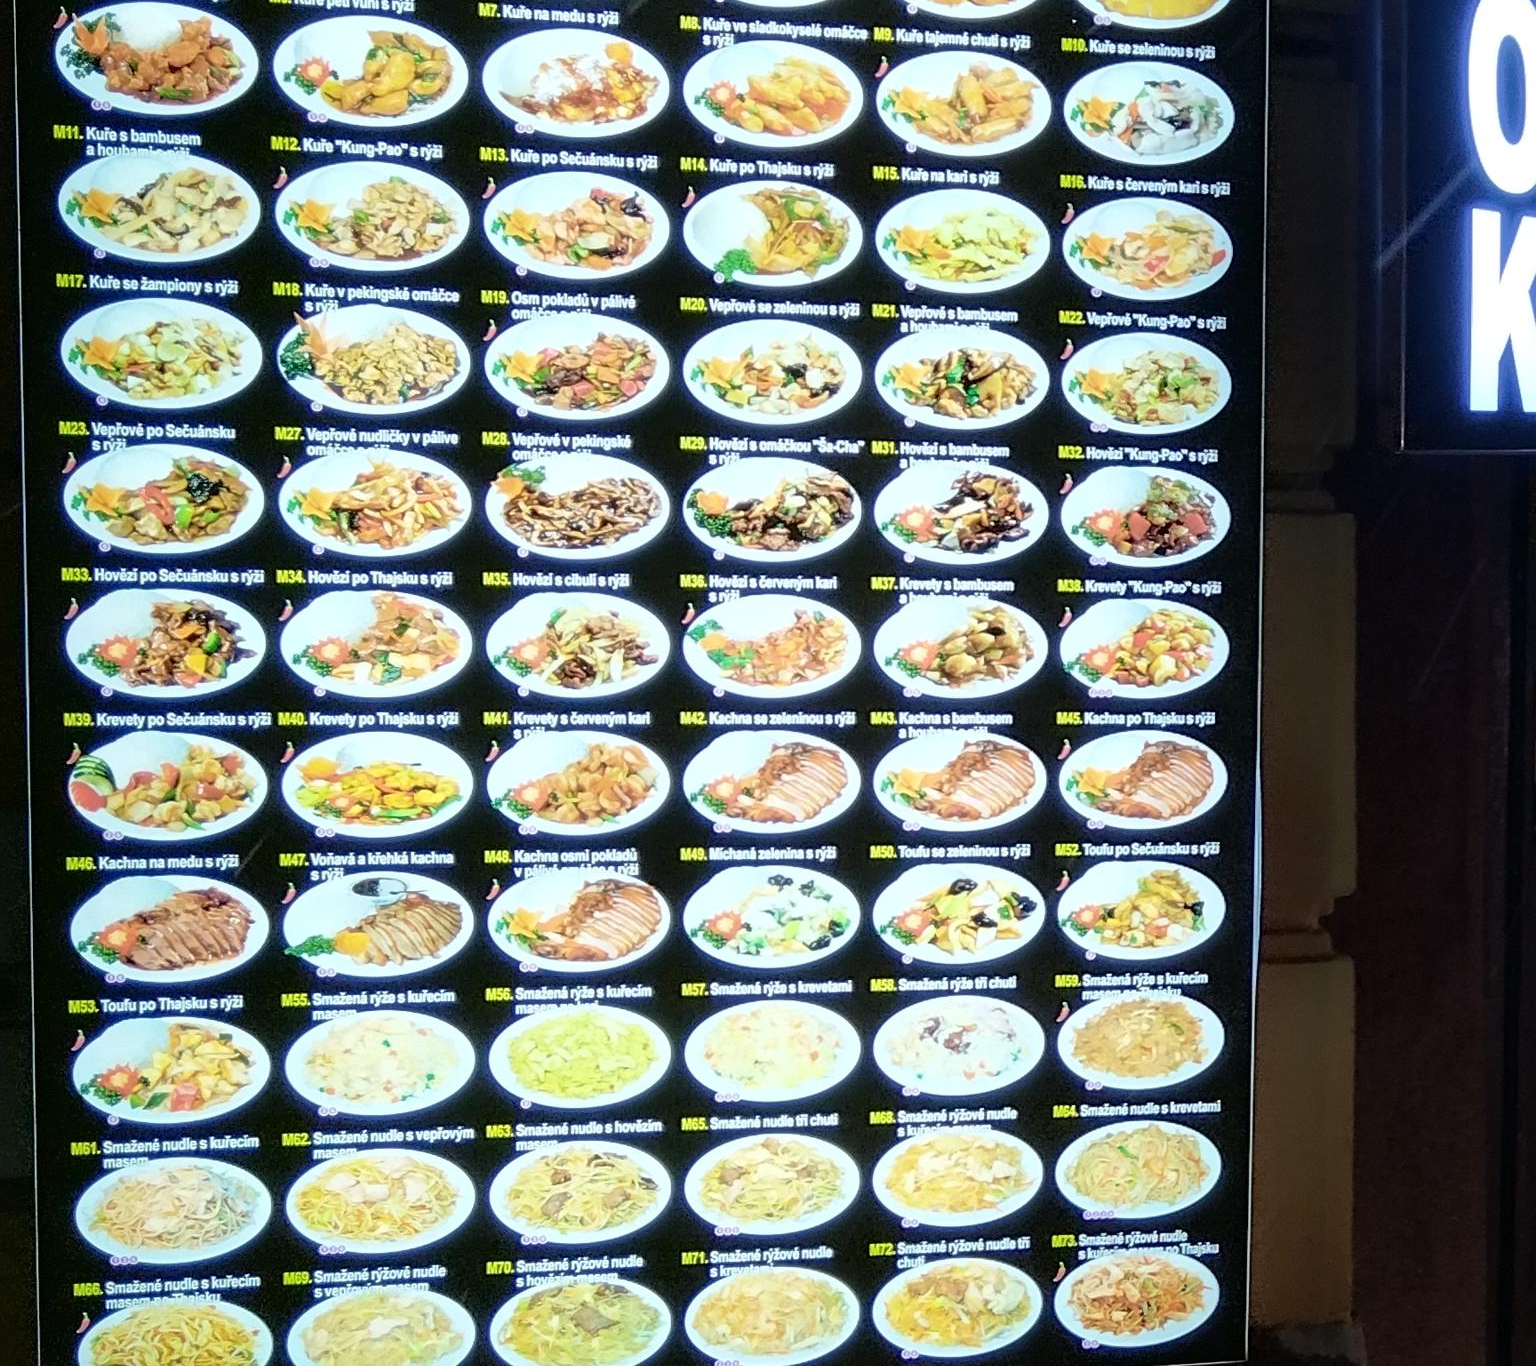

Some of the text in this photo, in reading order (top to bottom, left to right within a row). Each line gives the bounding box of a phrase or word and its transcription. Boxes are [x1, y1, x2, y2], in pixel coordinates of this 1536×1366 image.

[478, 2, 501, 17] M7.
[502, 4, 533, 20] Kuře
[533, 9, 550, 21] na
[551, 9, 586, 23] medu
[586, 12, 596, 24] s
[271, 135, 301, 151] M12.
[303, 137, 334, 153] Kuře
[409, 146, 419, 158] s
[479, 146, 509, 162] M13.
[511, 148, 540, 164] Kuře
[541, 153, 558, 167] po
[559, 150, 625, 168] Sečuánsku
[626, 157, 635, 168] s
[873, 165, 900, 180] M15.
[901, 167, 929, 182] Kuře
[930, 171, 945, 183] na
[946, 169, 969, 184] kari
[969, 173, 978, 184] s
[680, 297, 708, 311] M20.
[708, 298, 757, 315] Vepřové
[757, 302, 773, 314] se
[772, 301, 828, 316] zeleninou
[829, 304, 838, 316] s
[59, 421, 236, 440] M23. Vepřové po Sečuánsku
[276, 569, 307, 584] M34.
[351, 573, 369, 587] po
[369, 570, 419, 588] Thajsku
[420, 573, 429, 585] s
[1085, 579, 1127, 596] Krevety
[1192, 583, 1201, 594] s
[708, 711, 753, 725] Kachna
[753, 714, 769, 725] se
[768, 711, 824, 725] zeleninou
[824, 713, 834, 725] s
[869, 845, 898, 859] M50.
[897, 845, 931, 859] Toufu
[931, 847, 946, 858] se
[946, 844, 1000, 858] zeleninou
[1000, 846, 1009, 857] s
[66, 857, 97, 870] M46.
[98, 856, 147, 870] Kachna
[149, 858, 165, 869] na
[167, 854, 203, 869] medu
[204, 857, 214, 868] s
[681, 979, 853, 997] M57. Smažená rýže s krevetami
[1053, 1099, 1221, 1118] M64. Smažené nudle s krevetami
[71, 1141, 101, 1155] M61.
[102, 1138, 160, 1154] Smažené
[162, 1137, 198, 1151] nudle
[199, 1139, 208, 1150] s
[283, 1264, 447, 1285] M69. Smažené rýžové nudle
